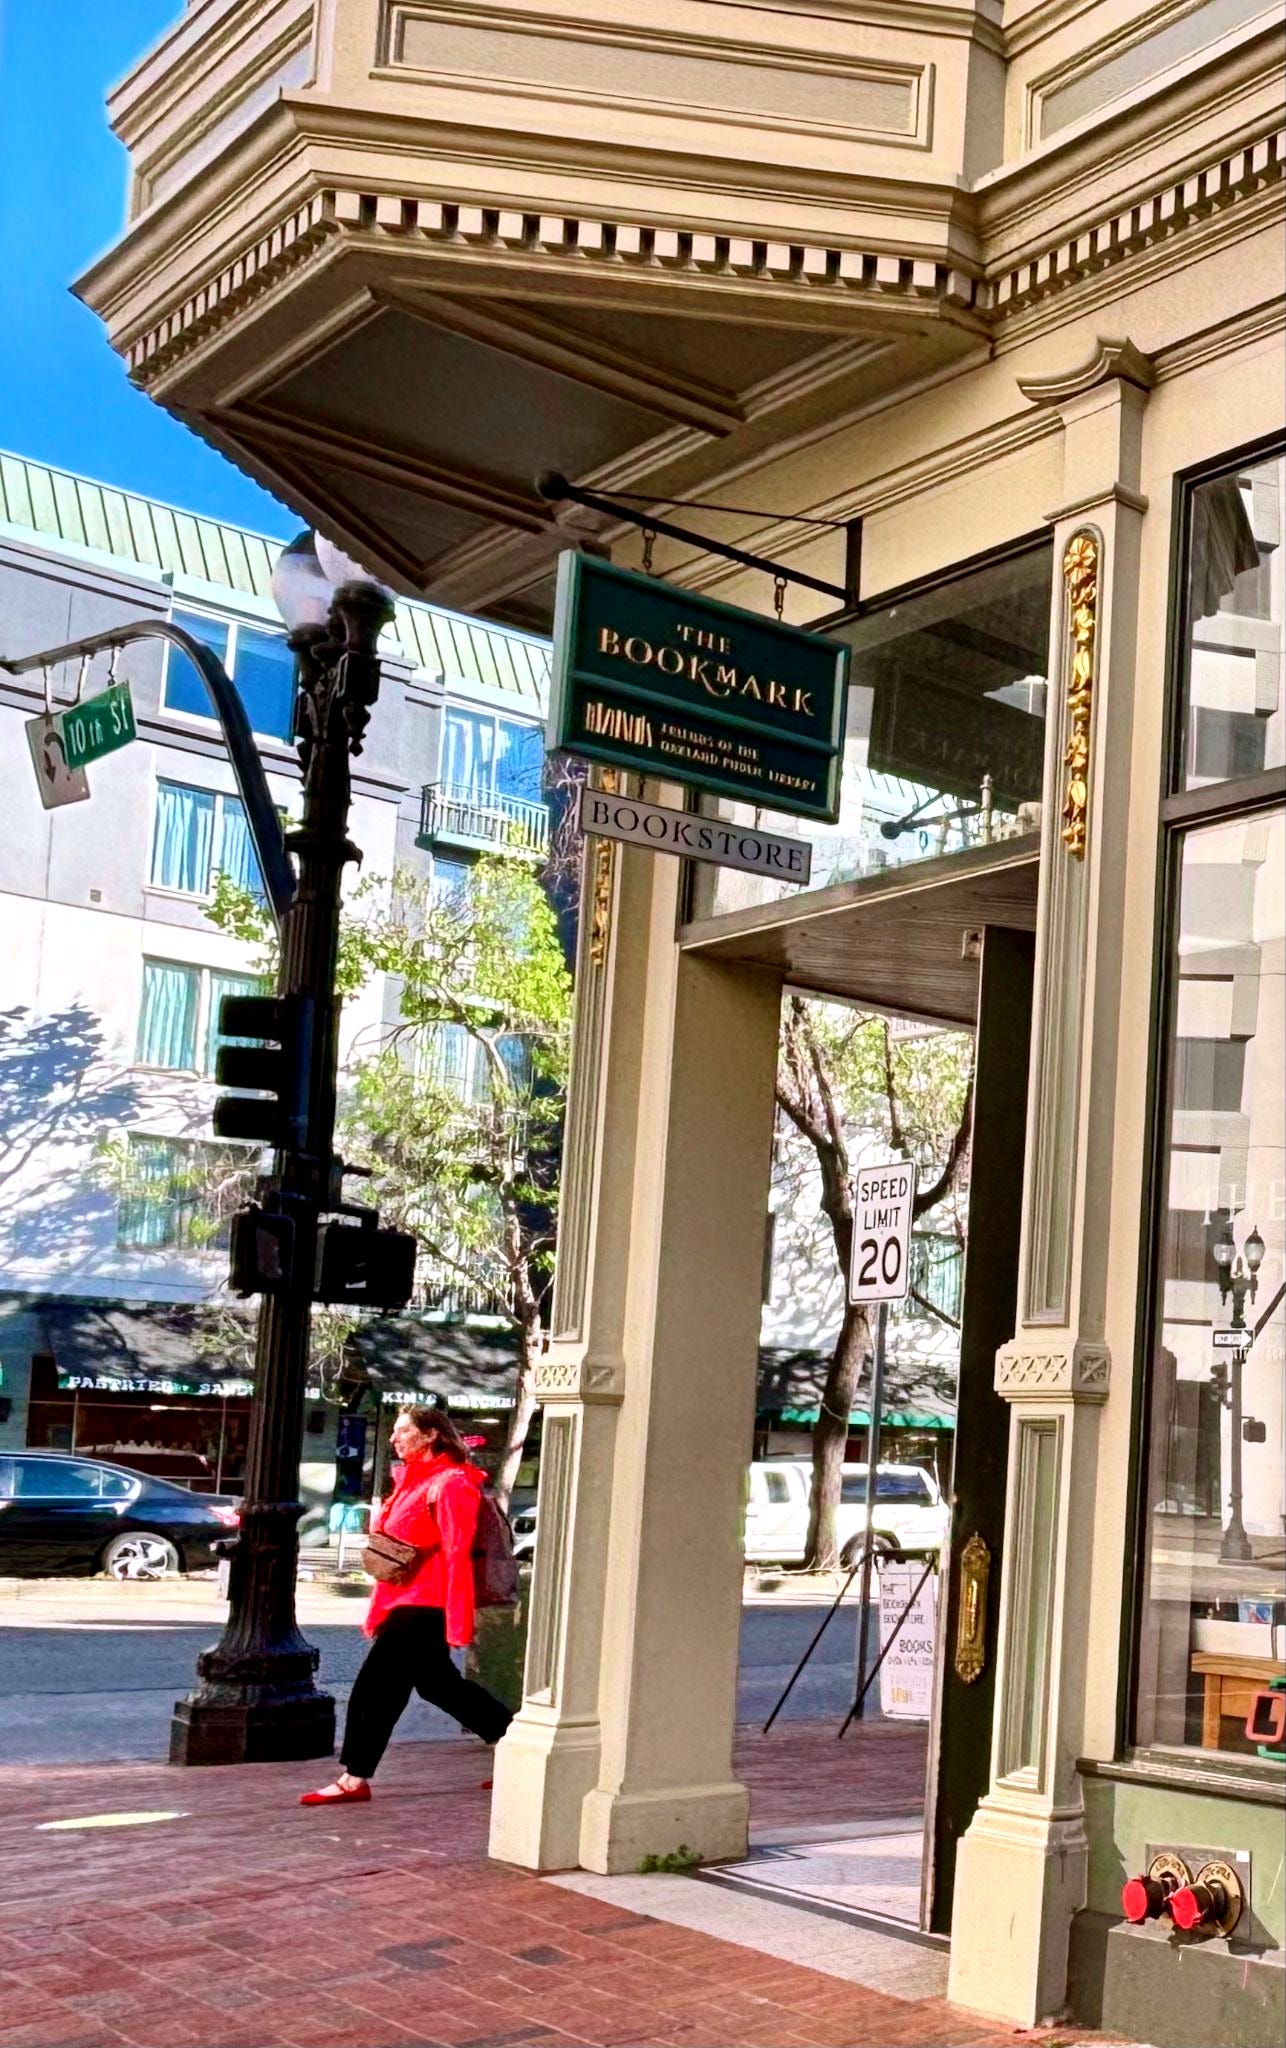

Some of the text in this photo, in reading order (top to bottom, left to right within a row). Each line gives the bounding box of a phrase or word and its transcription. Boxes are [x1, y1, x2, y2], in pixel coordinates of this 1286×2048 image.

[676, 624, 731, 655] THE
[599, 627, 815, 717] BOOKMARK
[592, 801, 804, 872] BOOKSTORE
[861, 1176, 908, 1202] SPEED
[864, 1207, 901, 1230] LIMIT
[858, 1236, 901, 1286] 20
[899, 1639, 933, 1654] BOOKS
